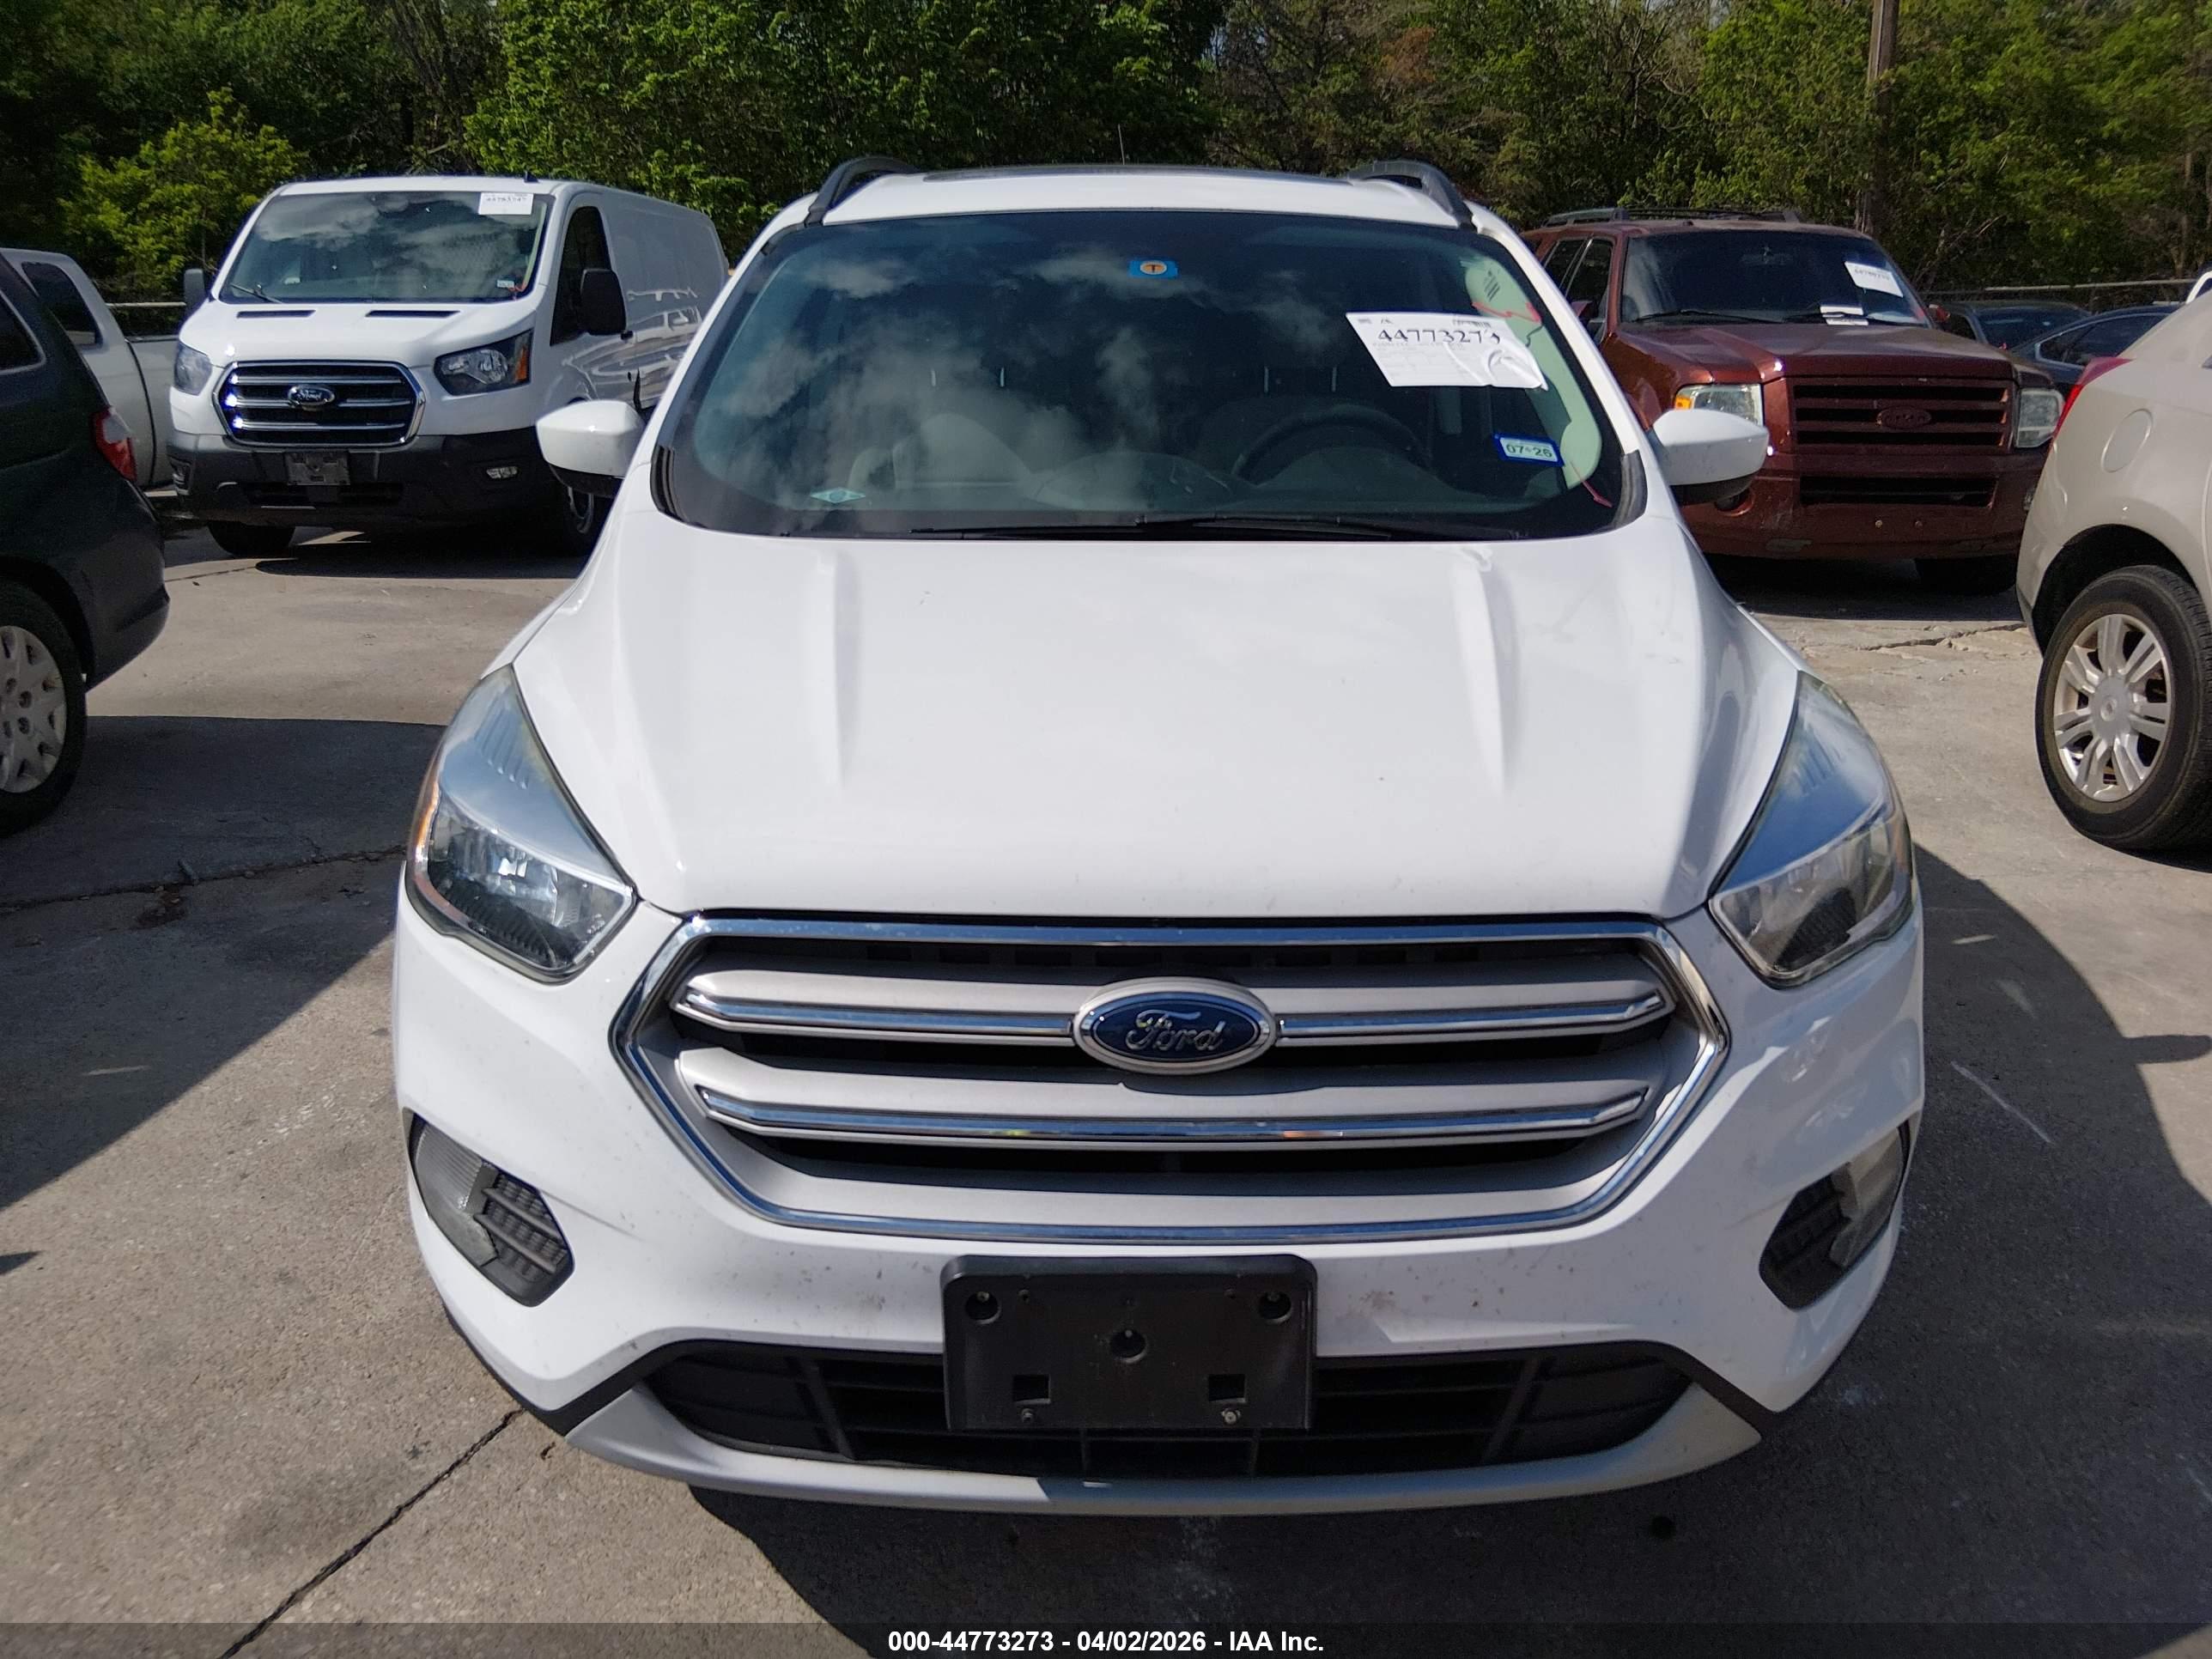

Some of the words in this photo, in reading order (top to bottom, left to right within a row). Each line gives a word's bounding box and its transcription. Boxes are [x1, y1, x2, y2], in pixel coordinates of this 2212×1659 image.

[1505, 444, 1524, 454] 07
[1532, 447, 1553, 458] 26
[1124, 1009, 1228, 1052] Ford
